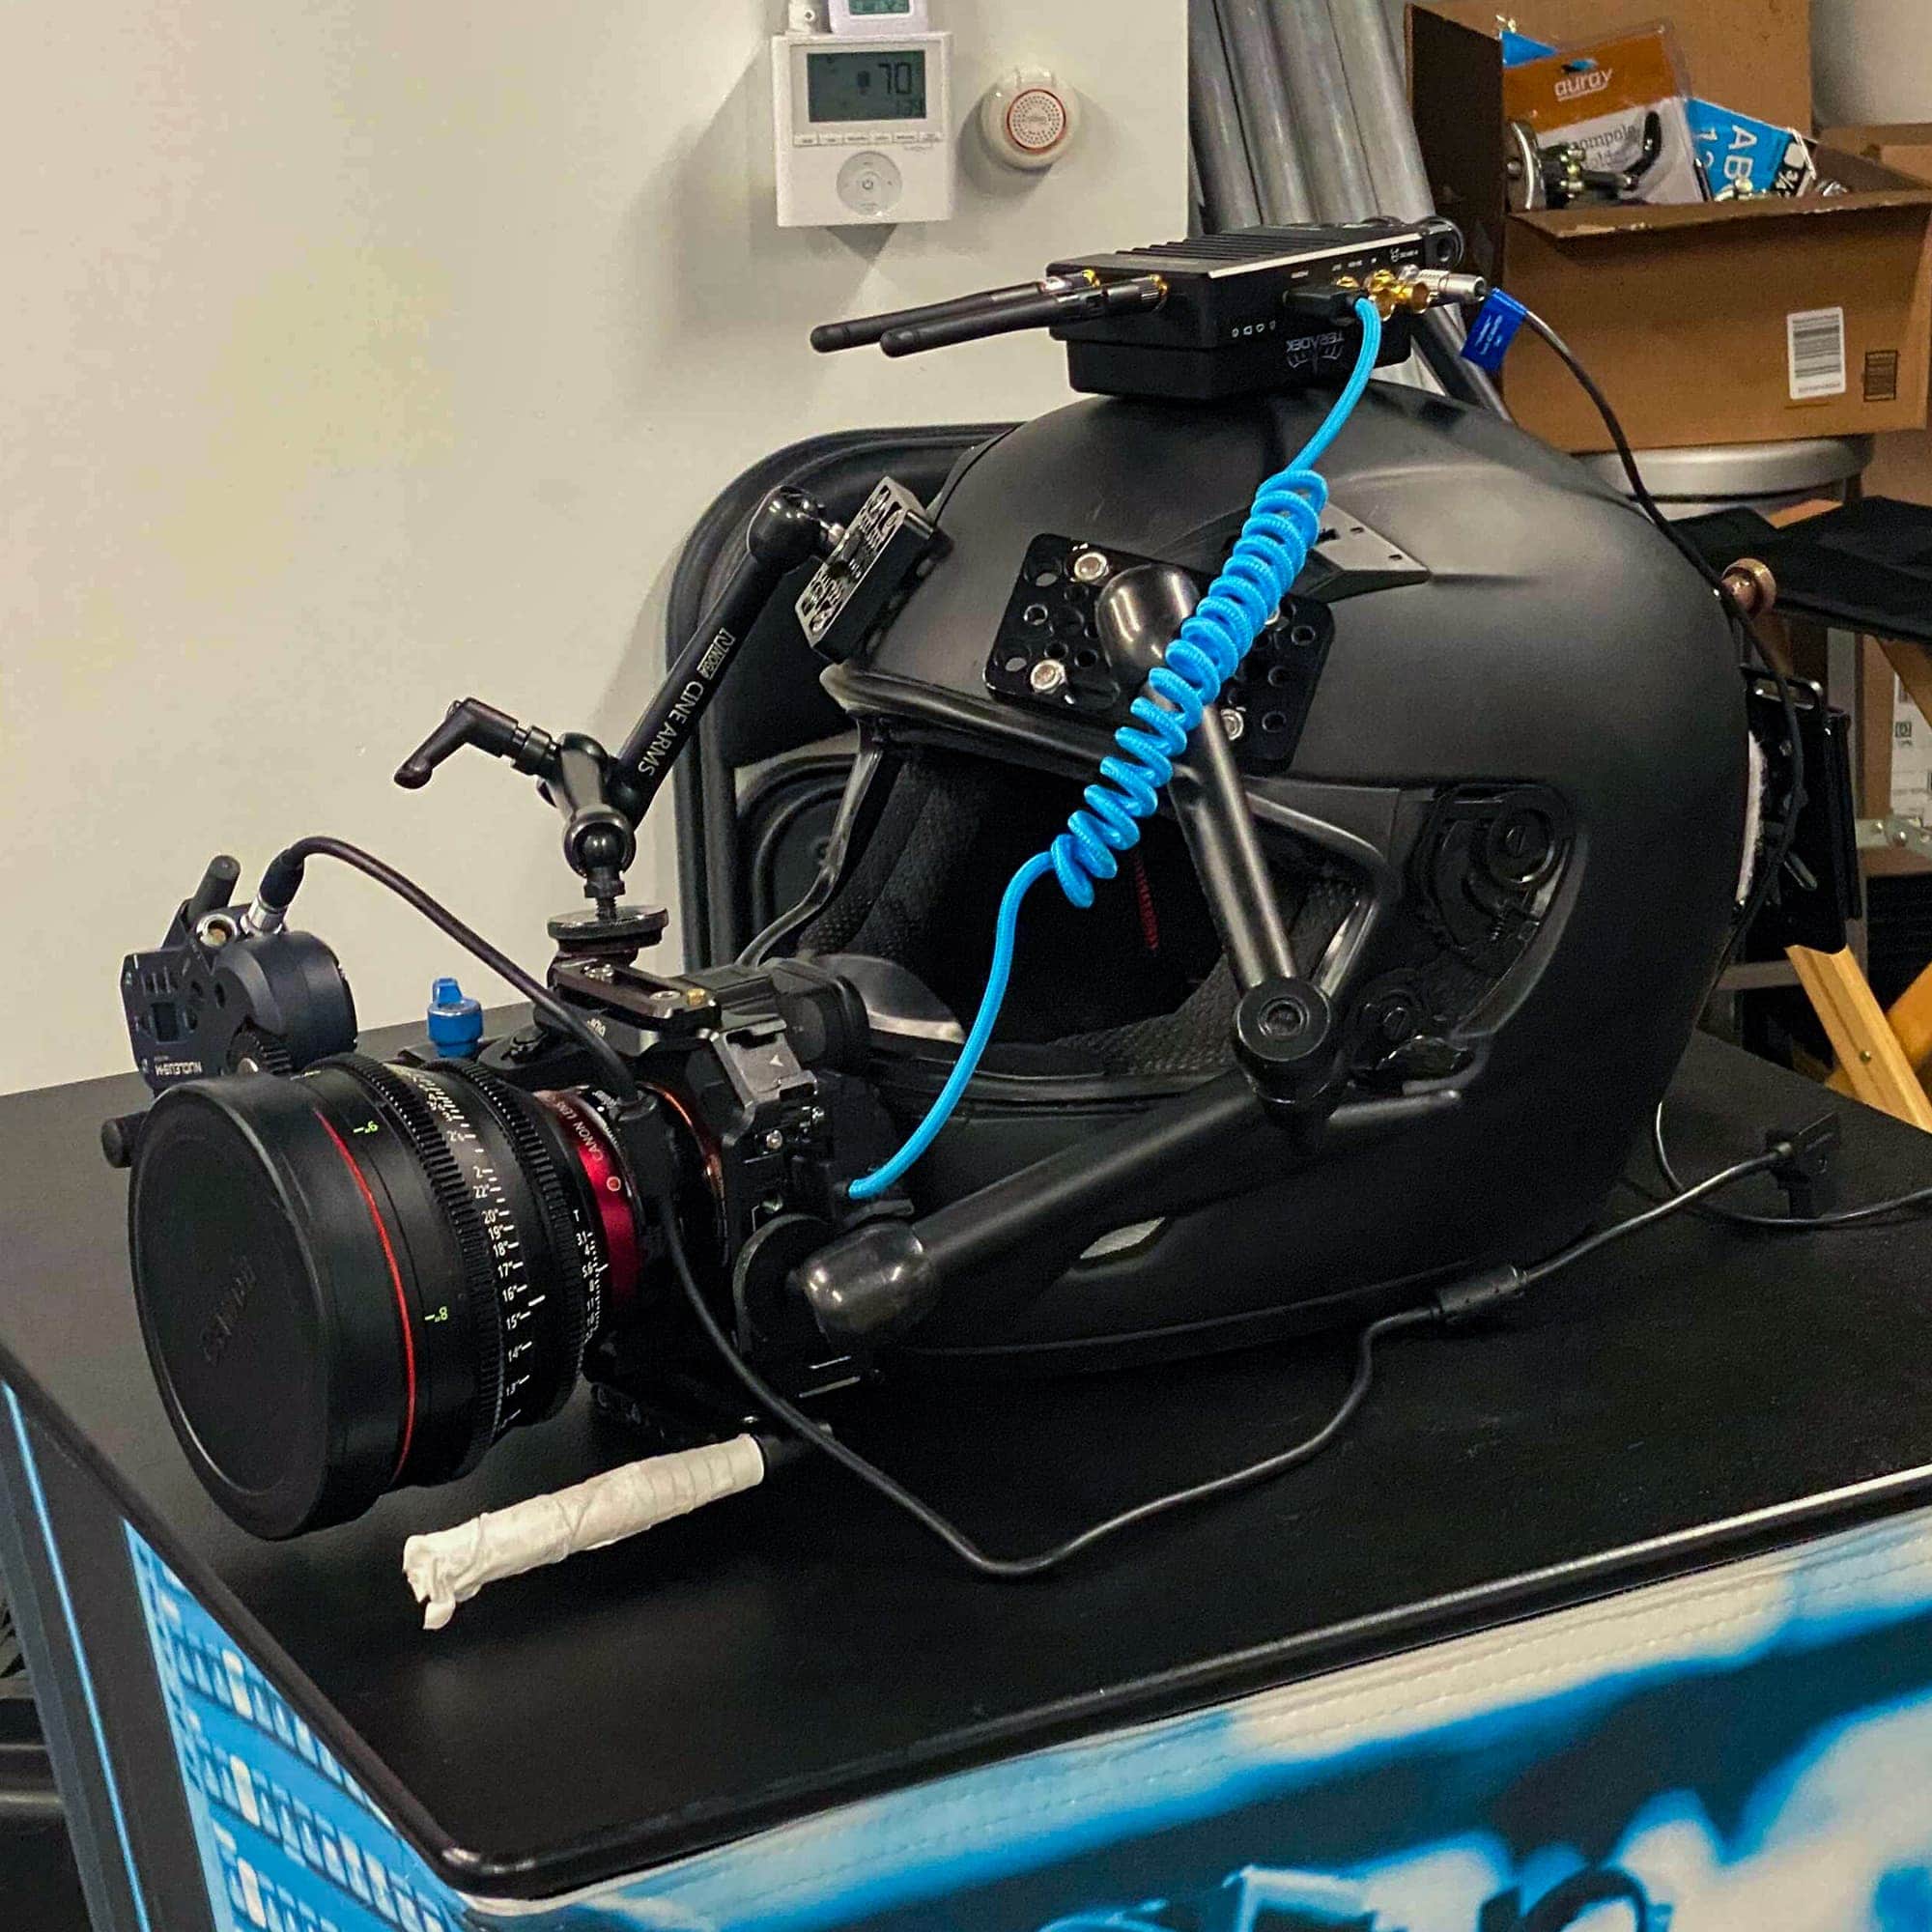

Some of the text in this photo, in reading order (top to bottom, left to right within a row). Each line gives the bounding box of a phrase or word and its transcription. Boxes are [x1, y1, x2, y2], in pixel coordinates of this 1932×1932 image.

[878, 62, 912, 95] 70
[1554, 68, 1612, 100] auray
[638, 681, 704, 777] CINE ARMS
[573, 1121, 604, 1161] CANON
